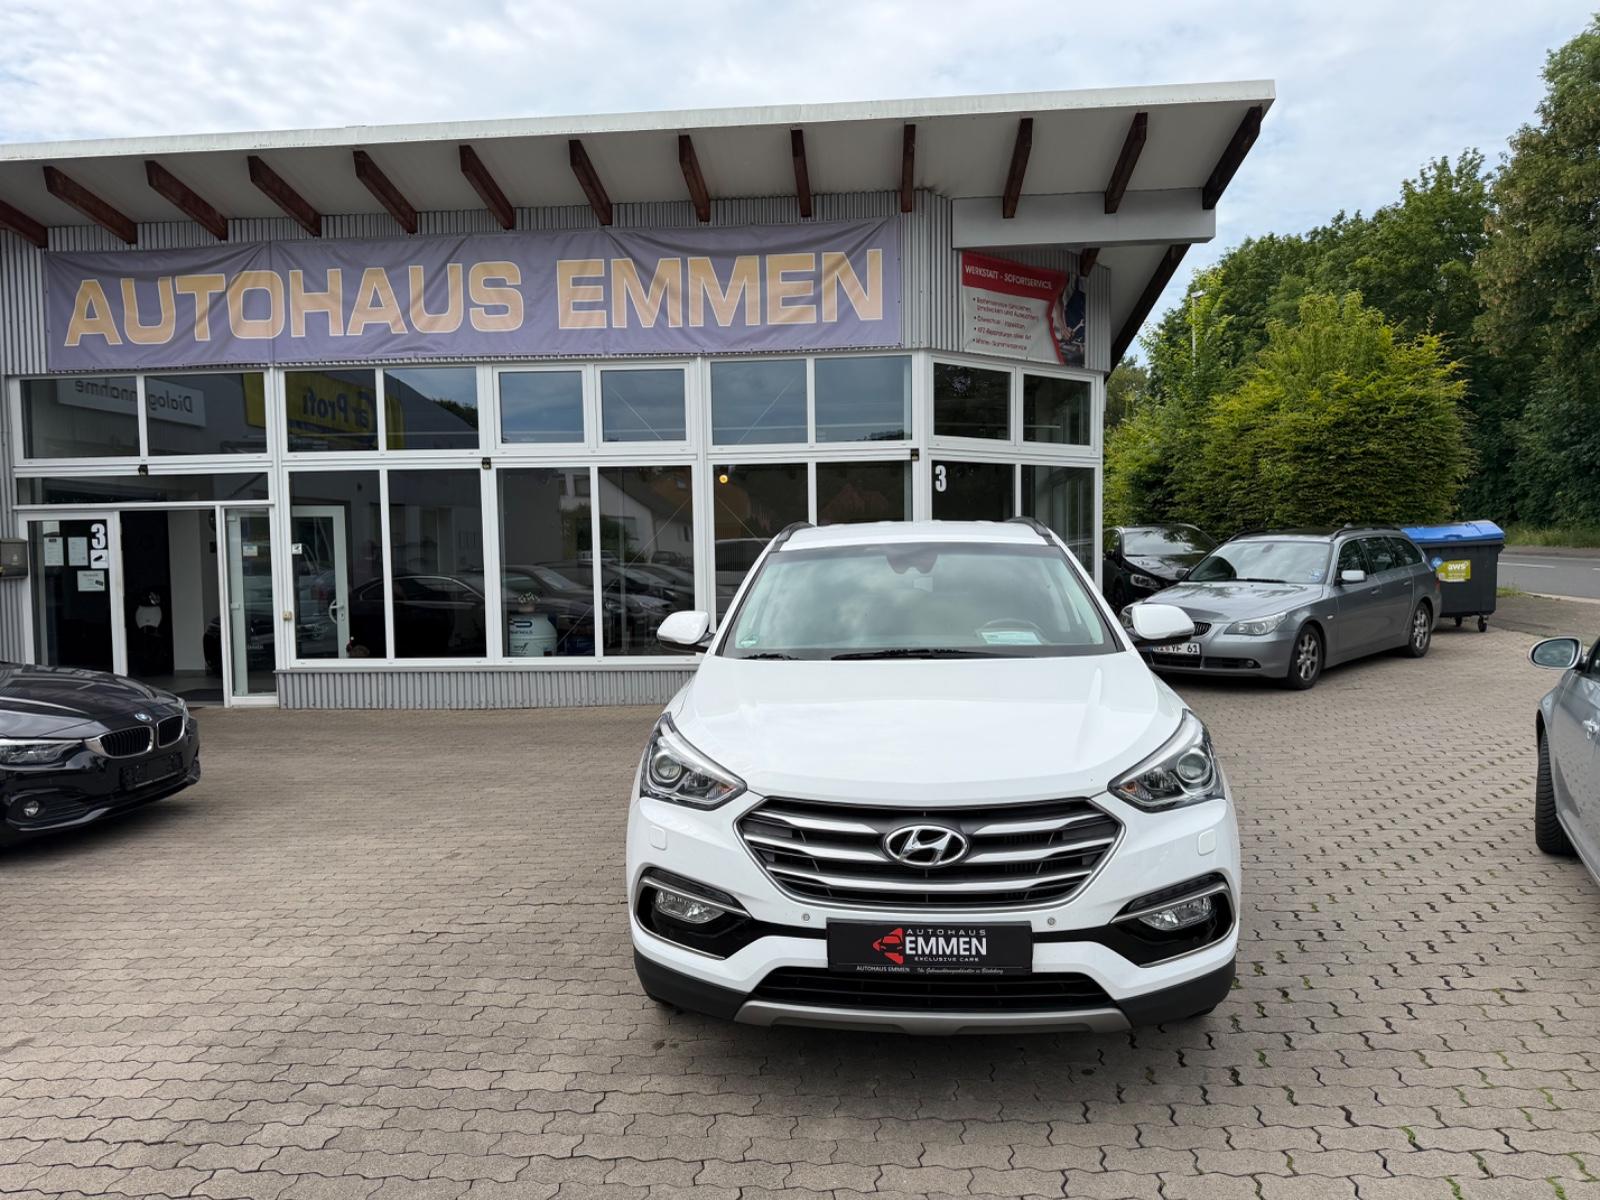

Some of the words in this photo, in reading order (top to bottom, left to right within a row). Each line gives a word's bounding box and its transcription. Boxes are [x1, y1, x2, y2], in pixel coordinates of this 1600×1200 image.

[965, 265, 999, 280] WERKSTATT
[1004, 273, 1053, 289] SOFORTSERVICE
[65, 261, 524, 347] AUTOHAUS
[556, 249, 883, 330] EMMEN
[935, 465, 947, 492] 3
[91, 523, 106, 549] 3
[1187, 643, 1198, 653] 61
[906, 928, 986, 936] AUTOHAUS
[905, 936, 987, 956] EMMEN
[856, 965, 887, 973] AUTOHAUS
